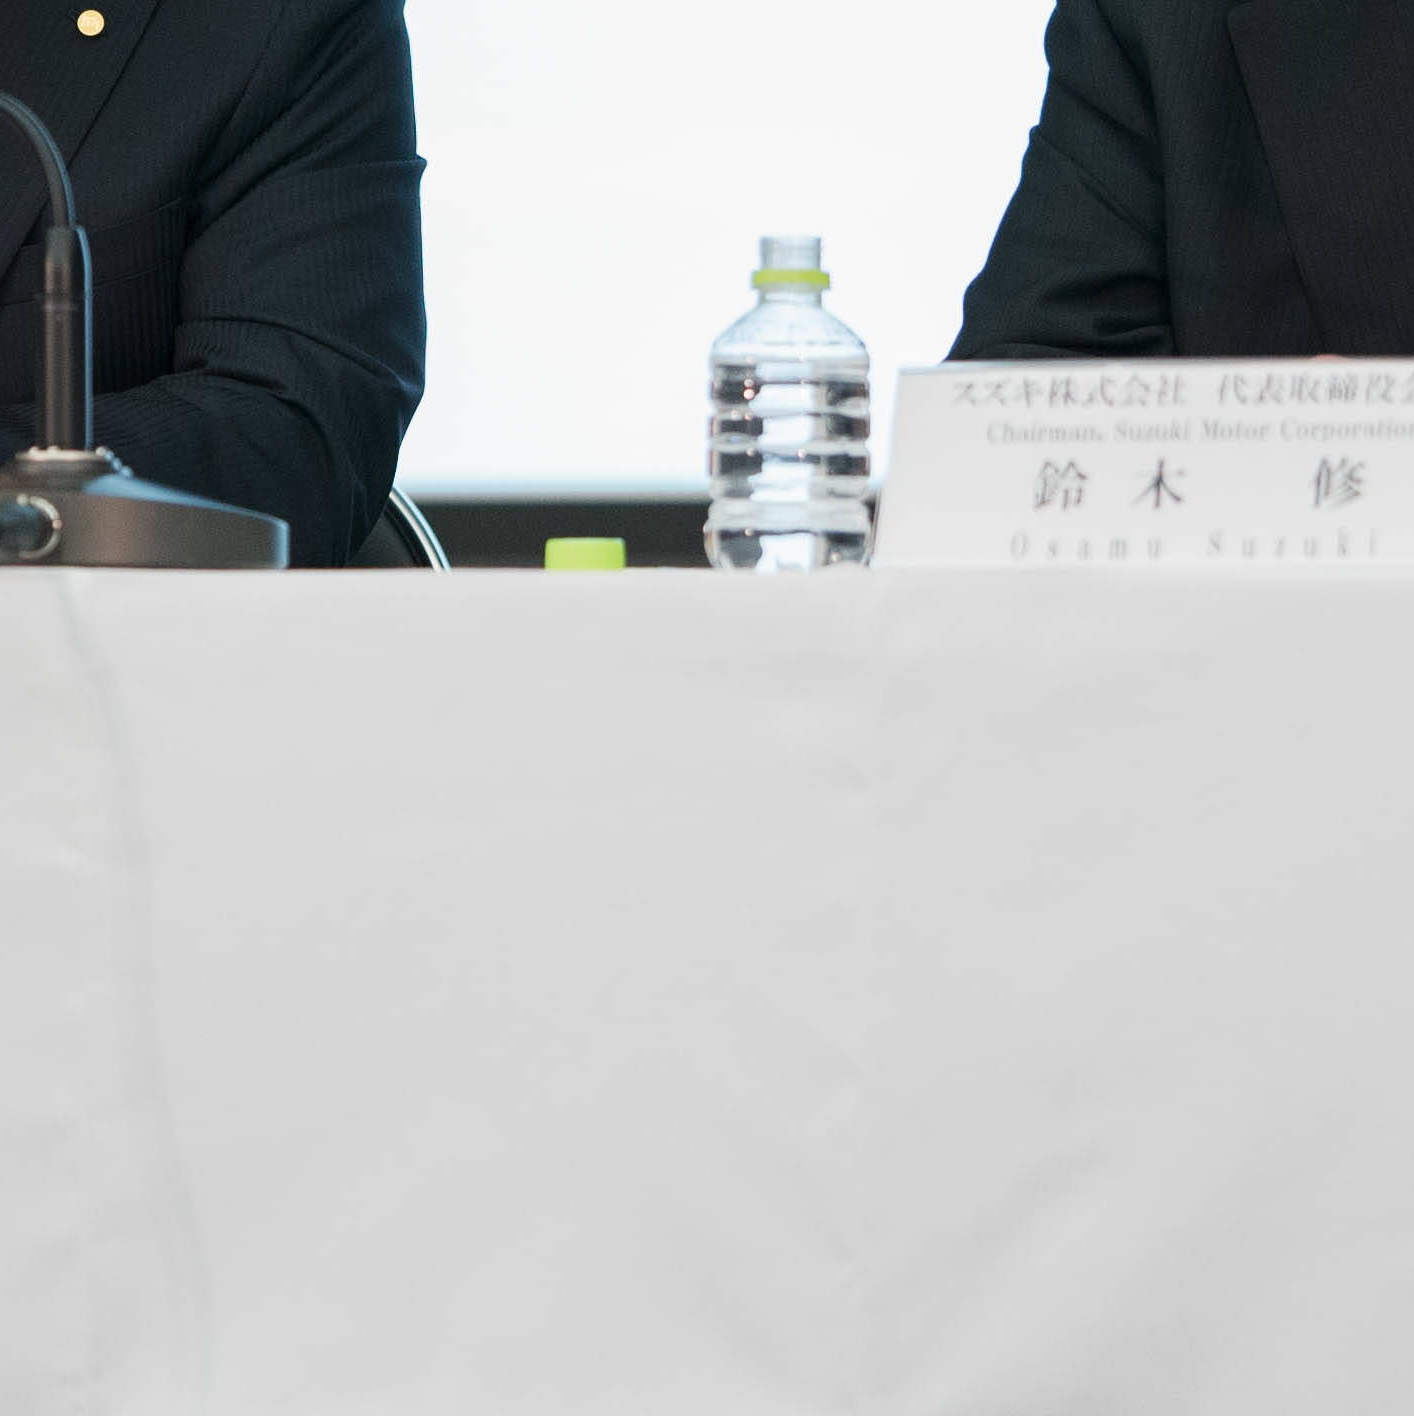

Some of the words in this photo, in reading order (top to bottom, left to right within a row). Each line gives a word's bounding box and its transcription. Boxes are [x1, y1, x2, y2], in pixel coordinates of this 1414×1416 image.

[952, 374, 1188, 407] スズキ株式会社
[1112, 419, 1191, 442] Suzuki
[1200, 418, 1271, 442] Motor
[1010, 530, 1164, 559] Osamu
[1206, 527, 1379, 559] Suzuki
